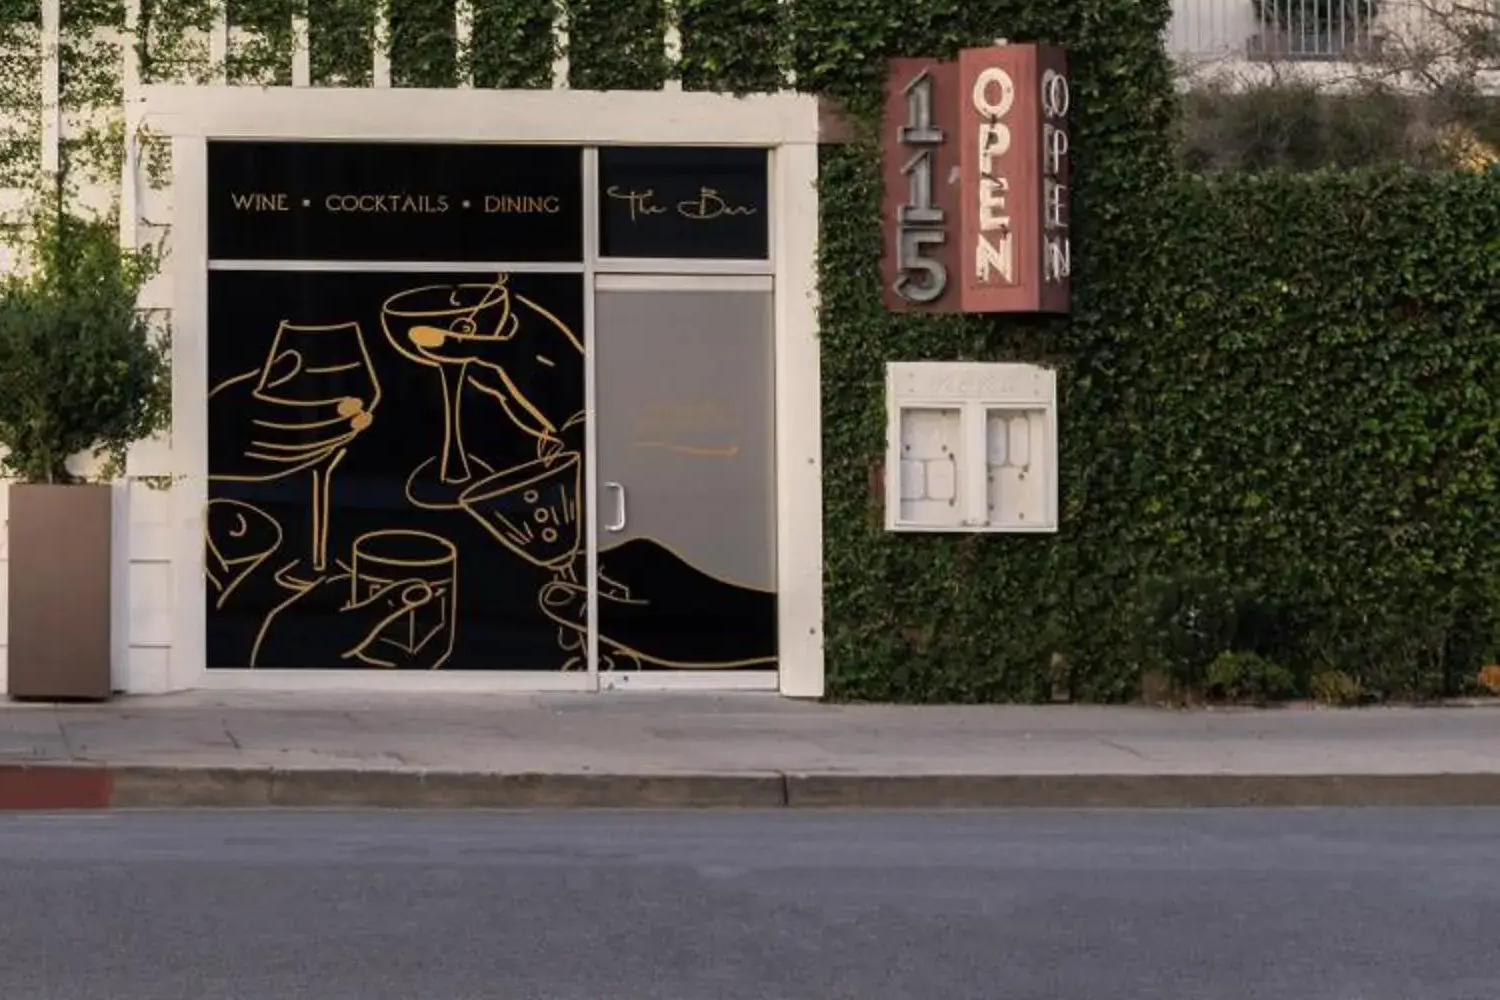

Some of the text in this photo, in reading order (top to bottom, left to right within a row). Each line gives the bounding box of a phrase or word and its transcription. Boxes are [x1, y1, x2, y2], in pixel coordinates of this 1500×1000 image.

[231, 192, 560, 214] WINE COCKTAILS DINING
[607, 184, 668, 222] The
[893, 64, 947, 301] 115
[972, 67, 1015, 284] OPEN
